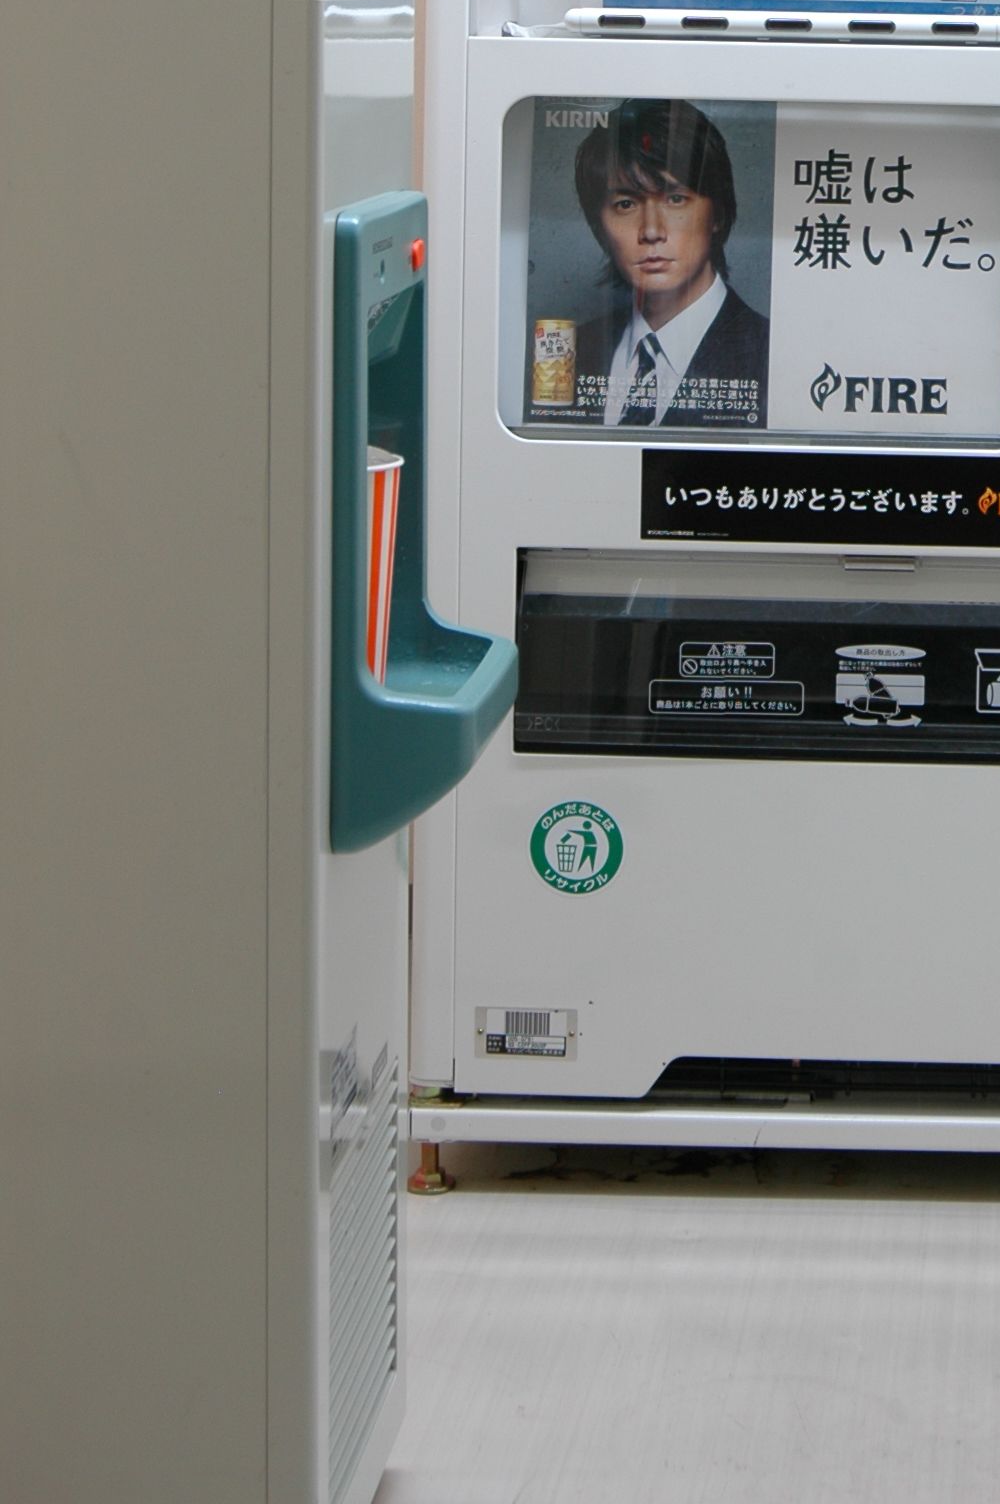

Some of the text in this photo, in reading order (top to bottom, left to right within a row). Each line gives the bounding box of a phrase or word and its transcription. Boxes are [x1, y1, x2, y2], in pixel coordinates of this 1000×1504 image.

[545, 109, 610, 129] KIRIN
[793, 148, 915, 205] 嘘は
[793, 213, 995, 272] 嫌いだ。
[843, 375, 948, 415] FIRE
[664, 485, 970, 516] いつもありがとうございます。
[722, 643, 748, 658] 注意
[540, 802, 616, 831] のんだあとは
[544, 868, 609, 892] リサイクル
